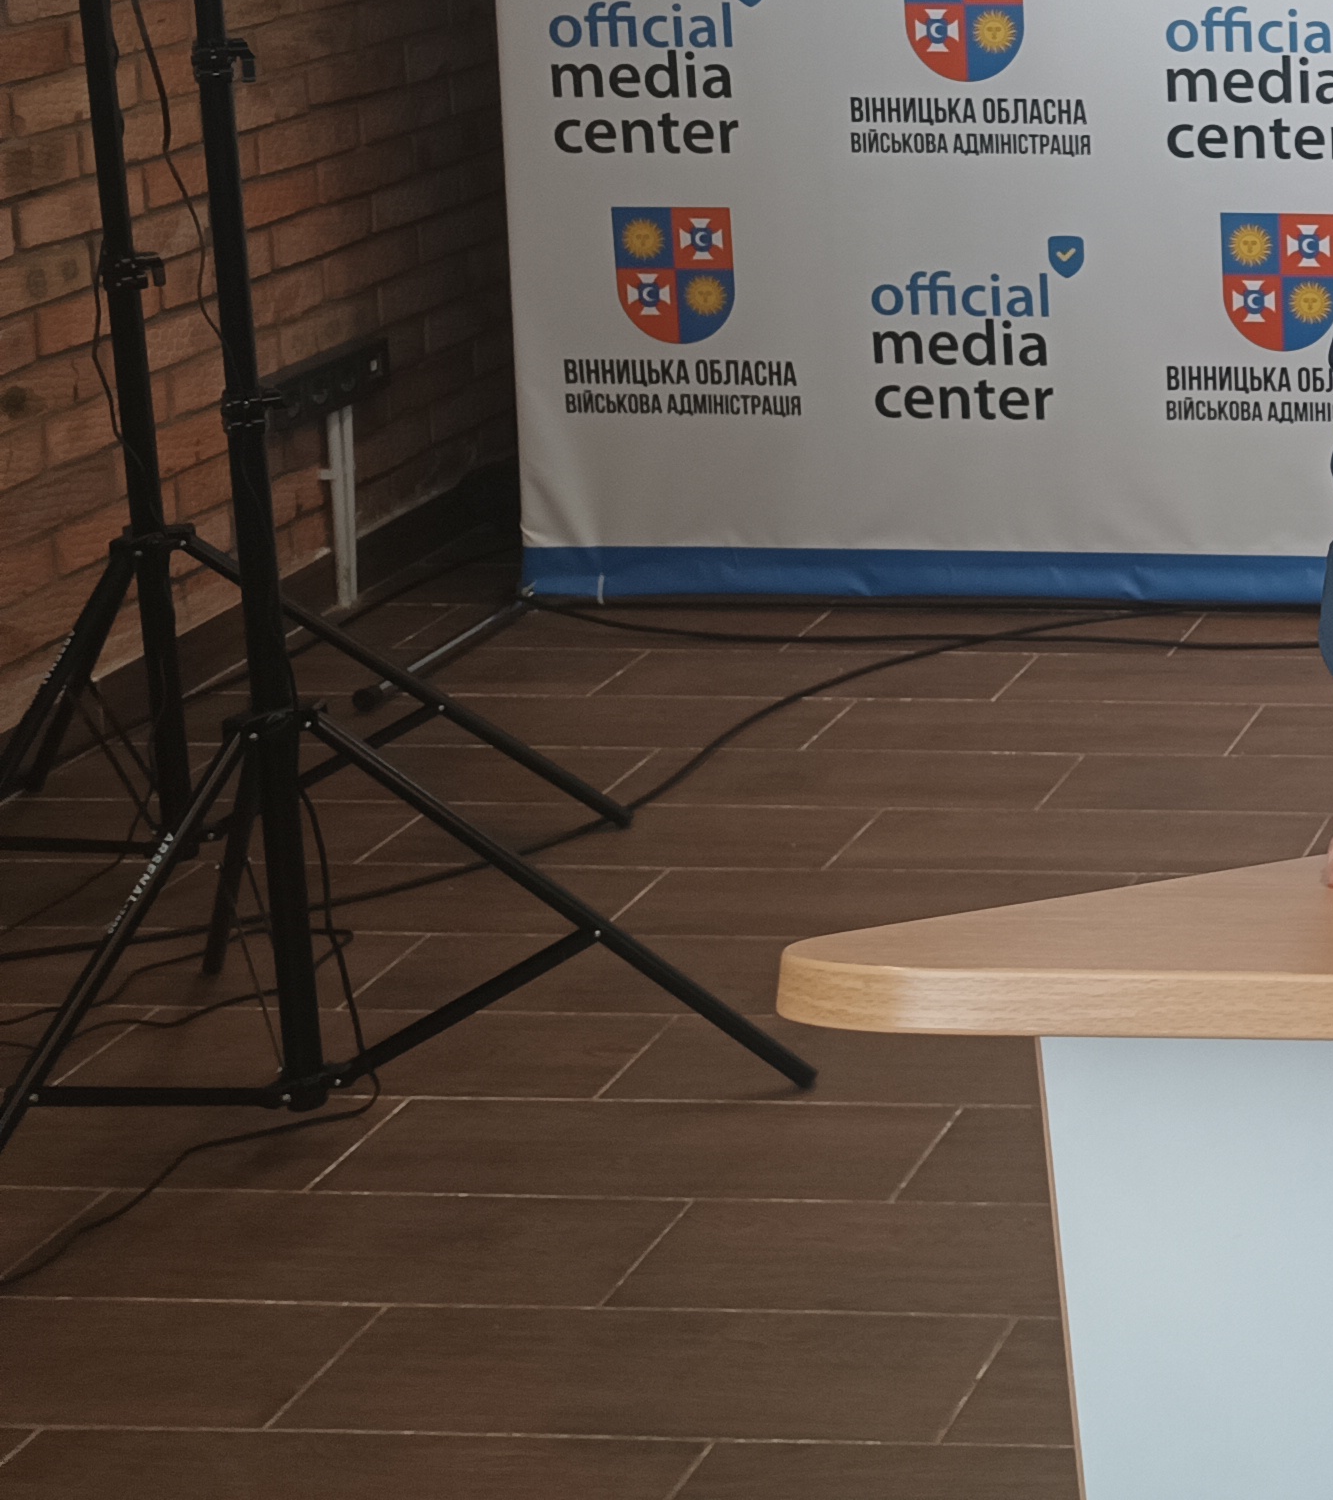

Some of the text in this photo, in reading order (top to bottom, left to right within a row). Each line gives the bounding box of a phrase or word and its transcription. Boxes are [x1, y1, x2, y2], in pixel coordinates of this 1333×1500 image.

[549, 1, 733, 48] official
[551, 49, 732, 98] media
[850, 97, 1087, 126] ВІННИЦЬКА ОБЛАСНА
[554, 112, 739, 154] center
[851, 129, 1091, 157] ВІЙСЬКОВА АДМІНІСТРАЦІЯ
[871, 271, 1049, 317] official
[873, 318, 1047, 366] media
[564, 359, 797, 387] ВІННИЦЬКА ОБЛАСНА
[1167, 366, 1291, 394] ВІННИЦЬКА
[565, 390, 801, 418] ВІЙСЬКОВА АДМІНІСТРАЦІЯ
[875, 380, 1053, 420] center
[1166, 397, 1263, 421] ВІЙСЬКОВА
[125, 832, 173, 902] ARSENAL
